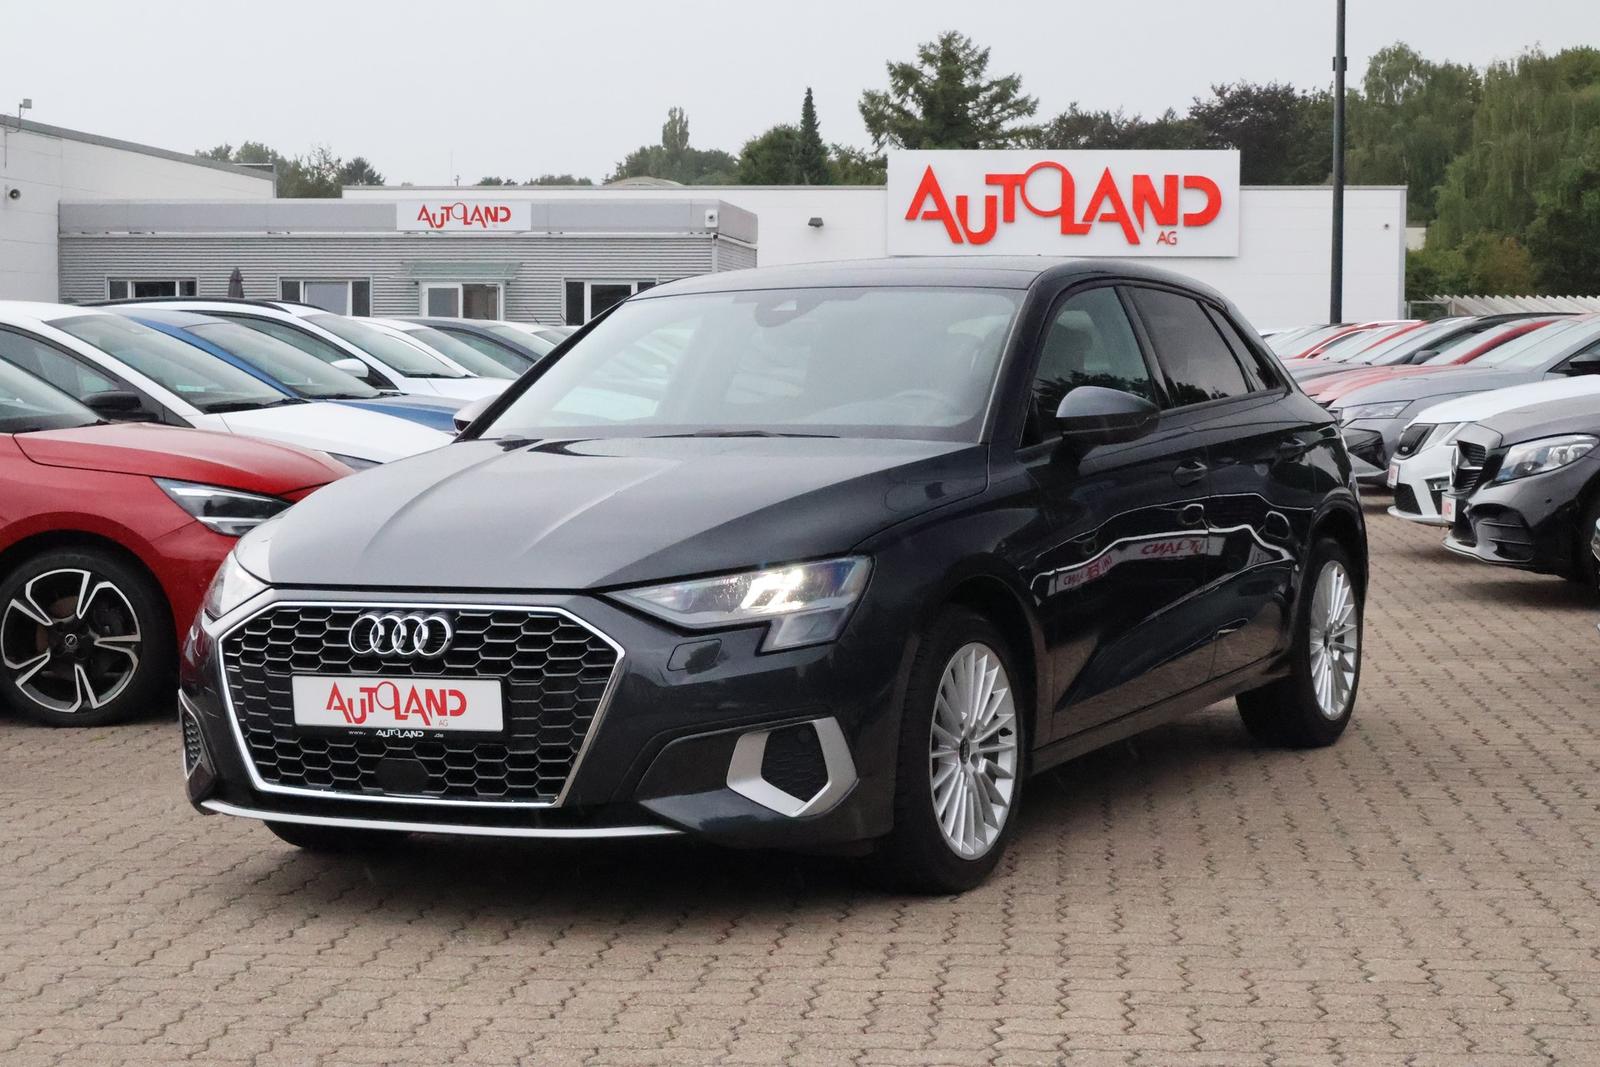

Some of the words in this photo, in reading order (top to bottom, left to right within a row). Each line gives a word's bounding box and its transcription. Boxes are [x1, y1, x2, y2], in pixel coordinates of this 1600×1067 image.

[905, 160, 1222, 246] AUTOLAND
[417, 203, 511, 228] AUTOLAND
[1156, 230, 1177, 246] AG
[326, 681, 467, 725] AUTOLAND
[438, 719, 448, 727] AG
[375, 728, 425, 739] AUTOLAND
